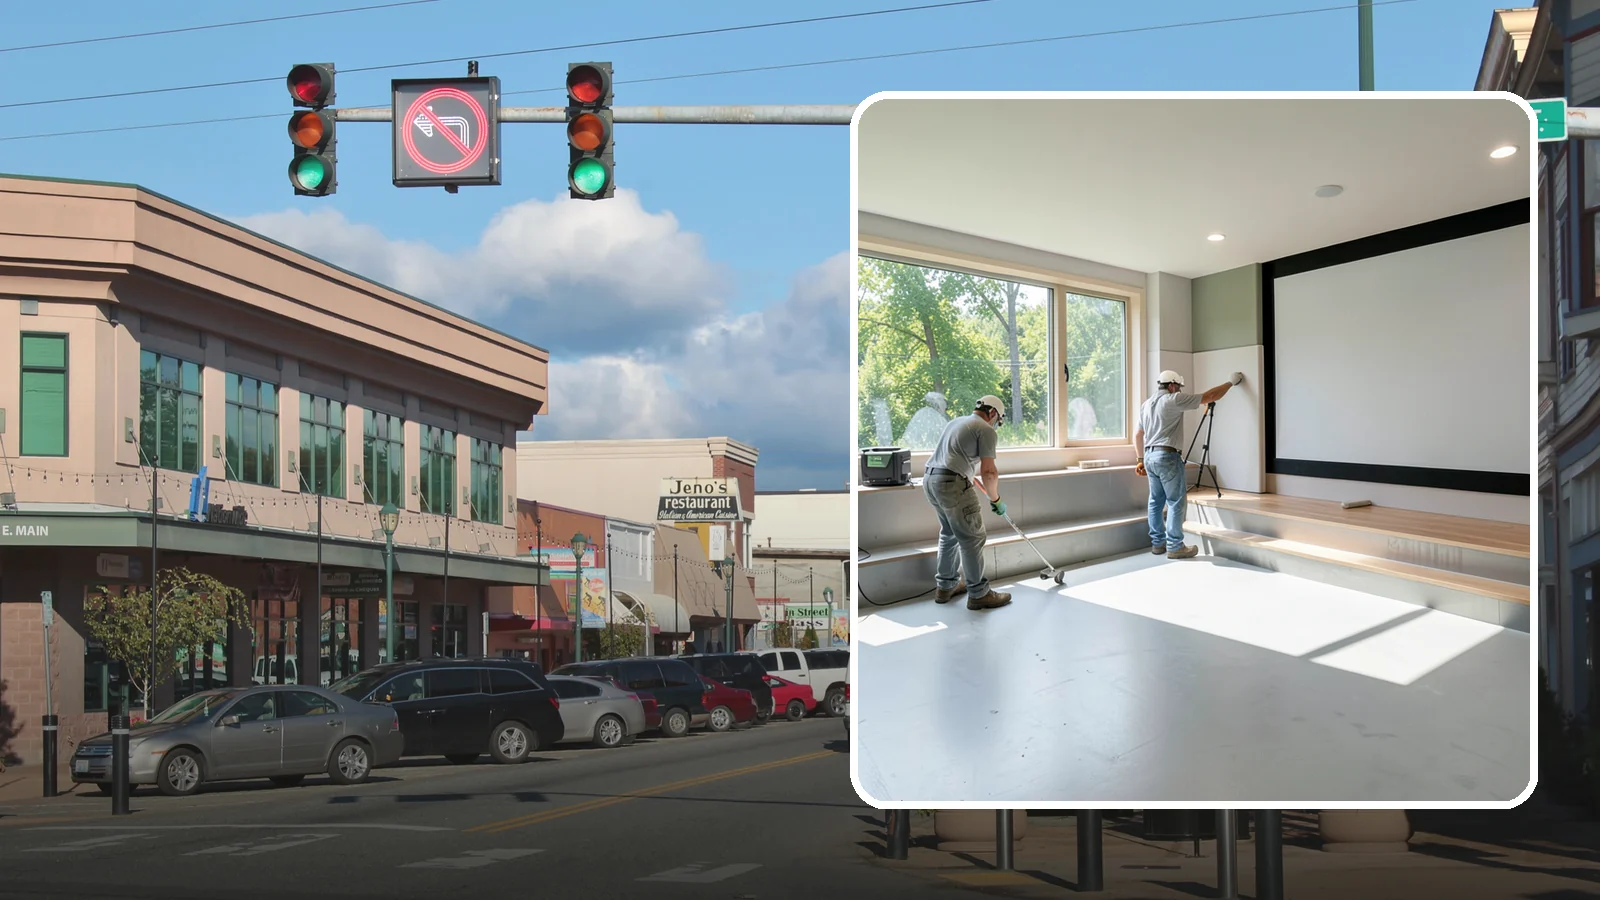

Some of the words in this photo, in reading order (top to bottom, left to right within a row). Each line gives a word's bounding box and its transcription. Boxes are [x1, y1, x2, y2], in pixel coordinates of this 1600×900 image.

[670, 480, 727, 494] Jeno's
[665, 496, 731, 509] restaurant
[658, 510, 681, 520] Italian
[686, 510, 714, 519] American
[715, 509, 737, 519] Cuisine
[2, 525, 13, 536] E.
[15, 525, 48, 536] MAIN
[798, 608, 828, 616] Street
[791, 619, 823, 627] lass
